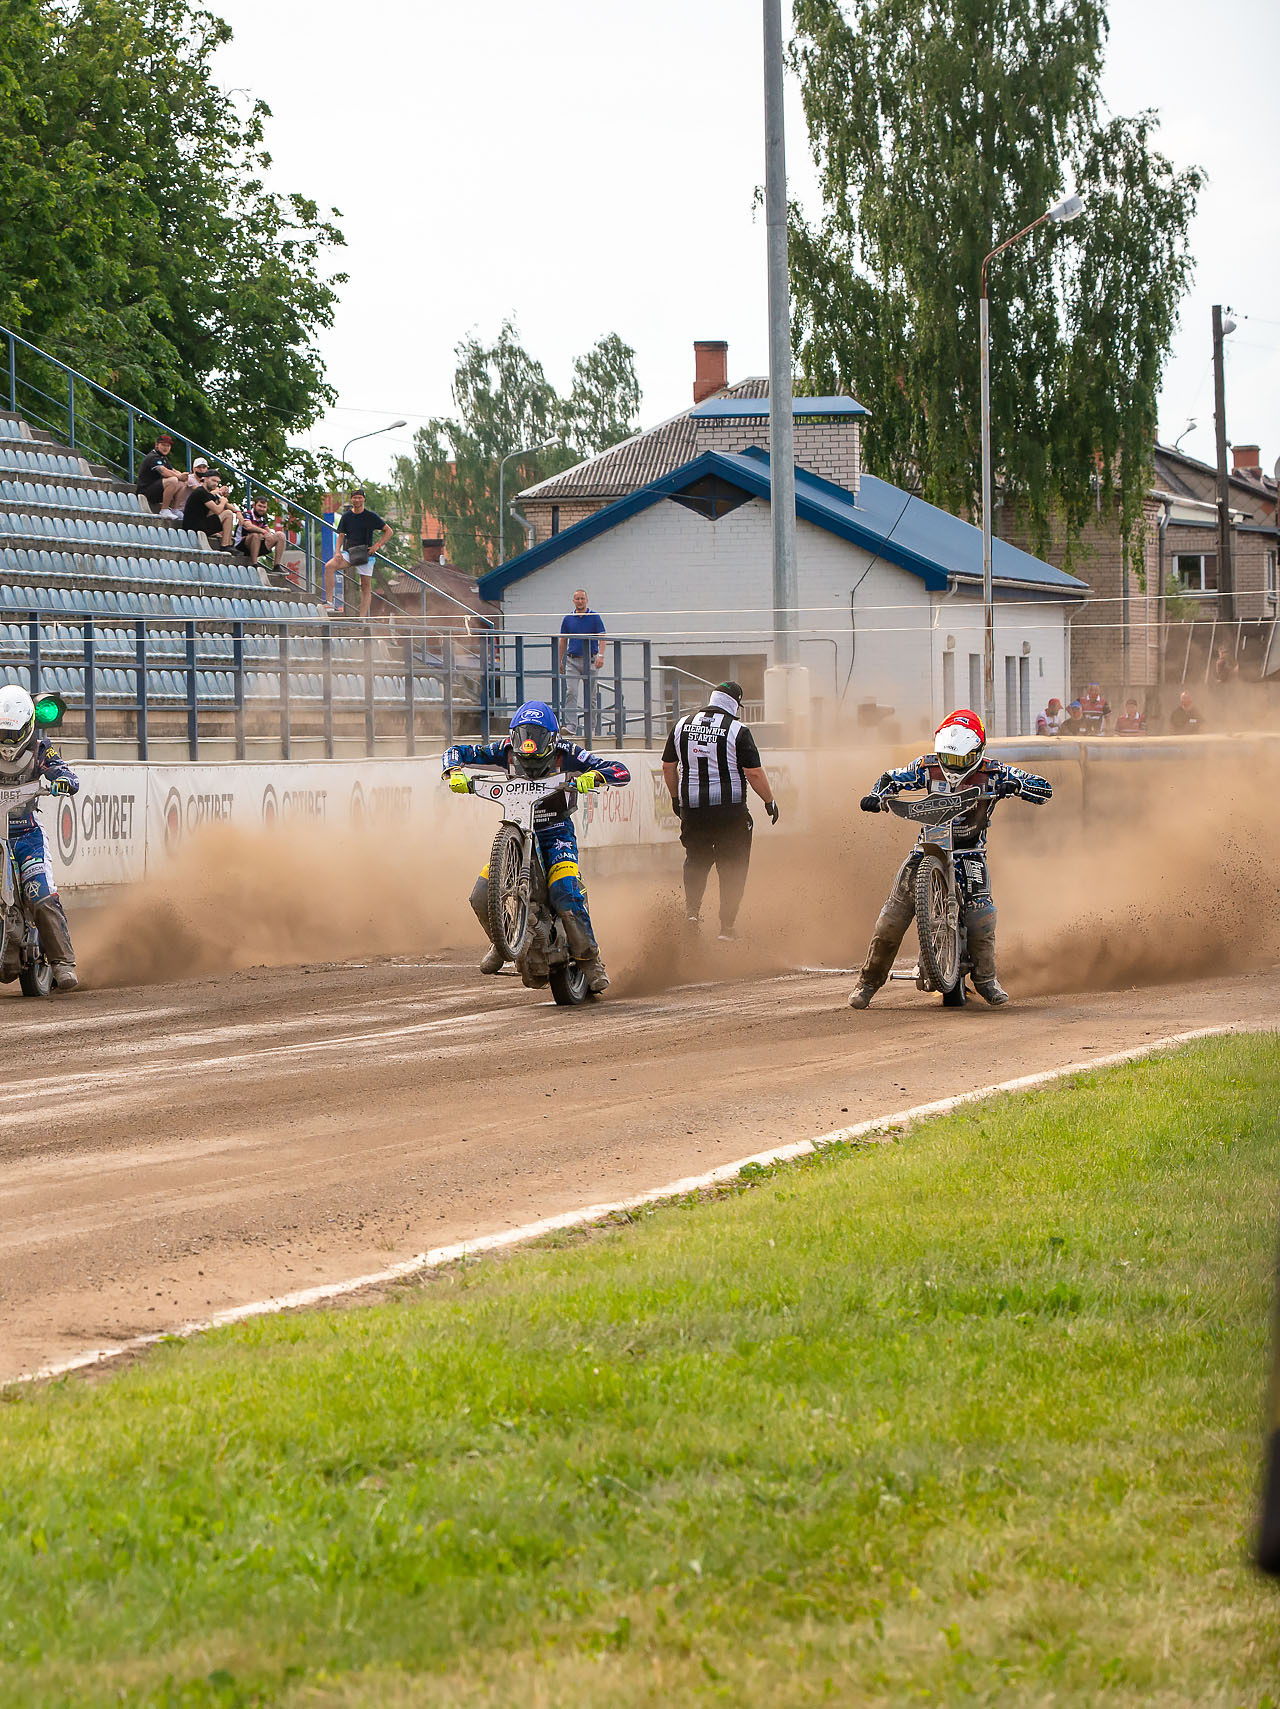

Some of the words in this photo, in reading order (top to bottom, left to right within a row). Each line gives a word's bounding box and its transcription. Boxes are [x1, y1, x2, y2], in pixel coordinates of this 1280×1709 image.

[683, 724, 726, 736] KIEROWNIK
[688, 733, 718, 743] STARTU
[506, 782, 547, 793] OPTIBET
[81, 794, 135, 841] OPTIBET
